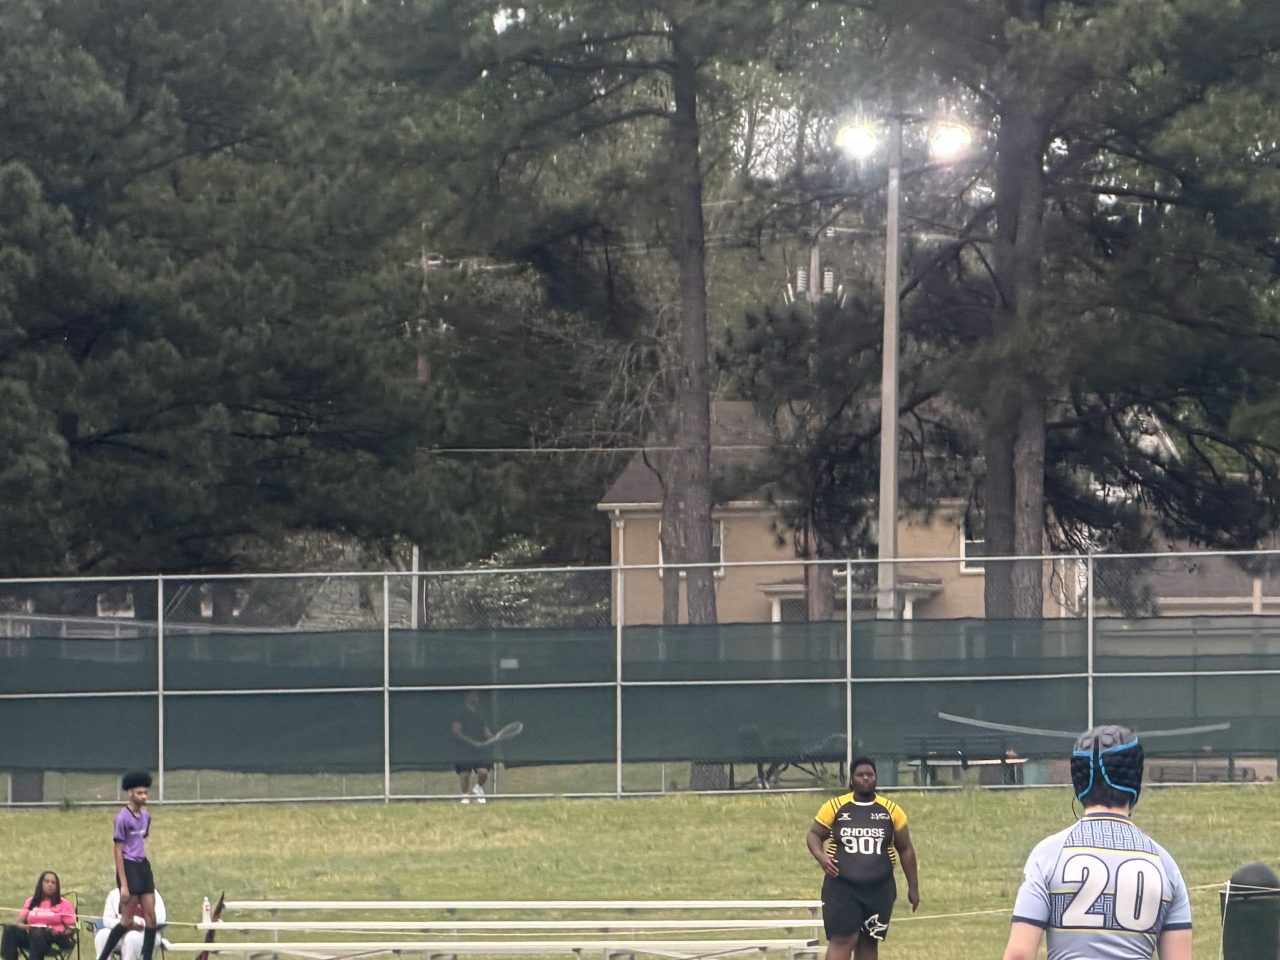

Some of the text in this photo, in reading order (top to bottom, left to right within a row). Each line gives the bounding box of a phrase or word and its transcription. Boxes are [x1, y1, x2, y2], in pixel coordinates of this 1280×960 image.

[840, 827, 885, 837] CHOOSE
[841, 836, 884, 855] 901
[1061, 853, 1164, 933] 20
